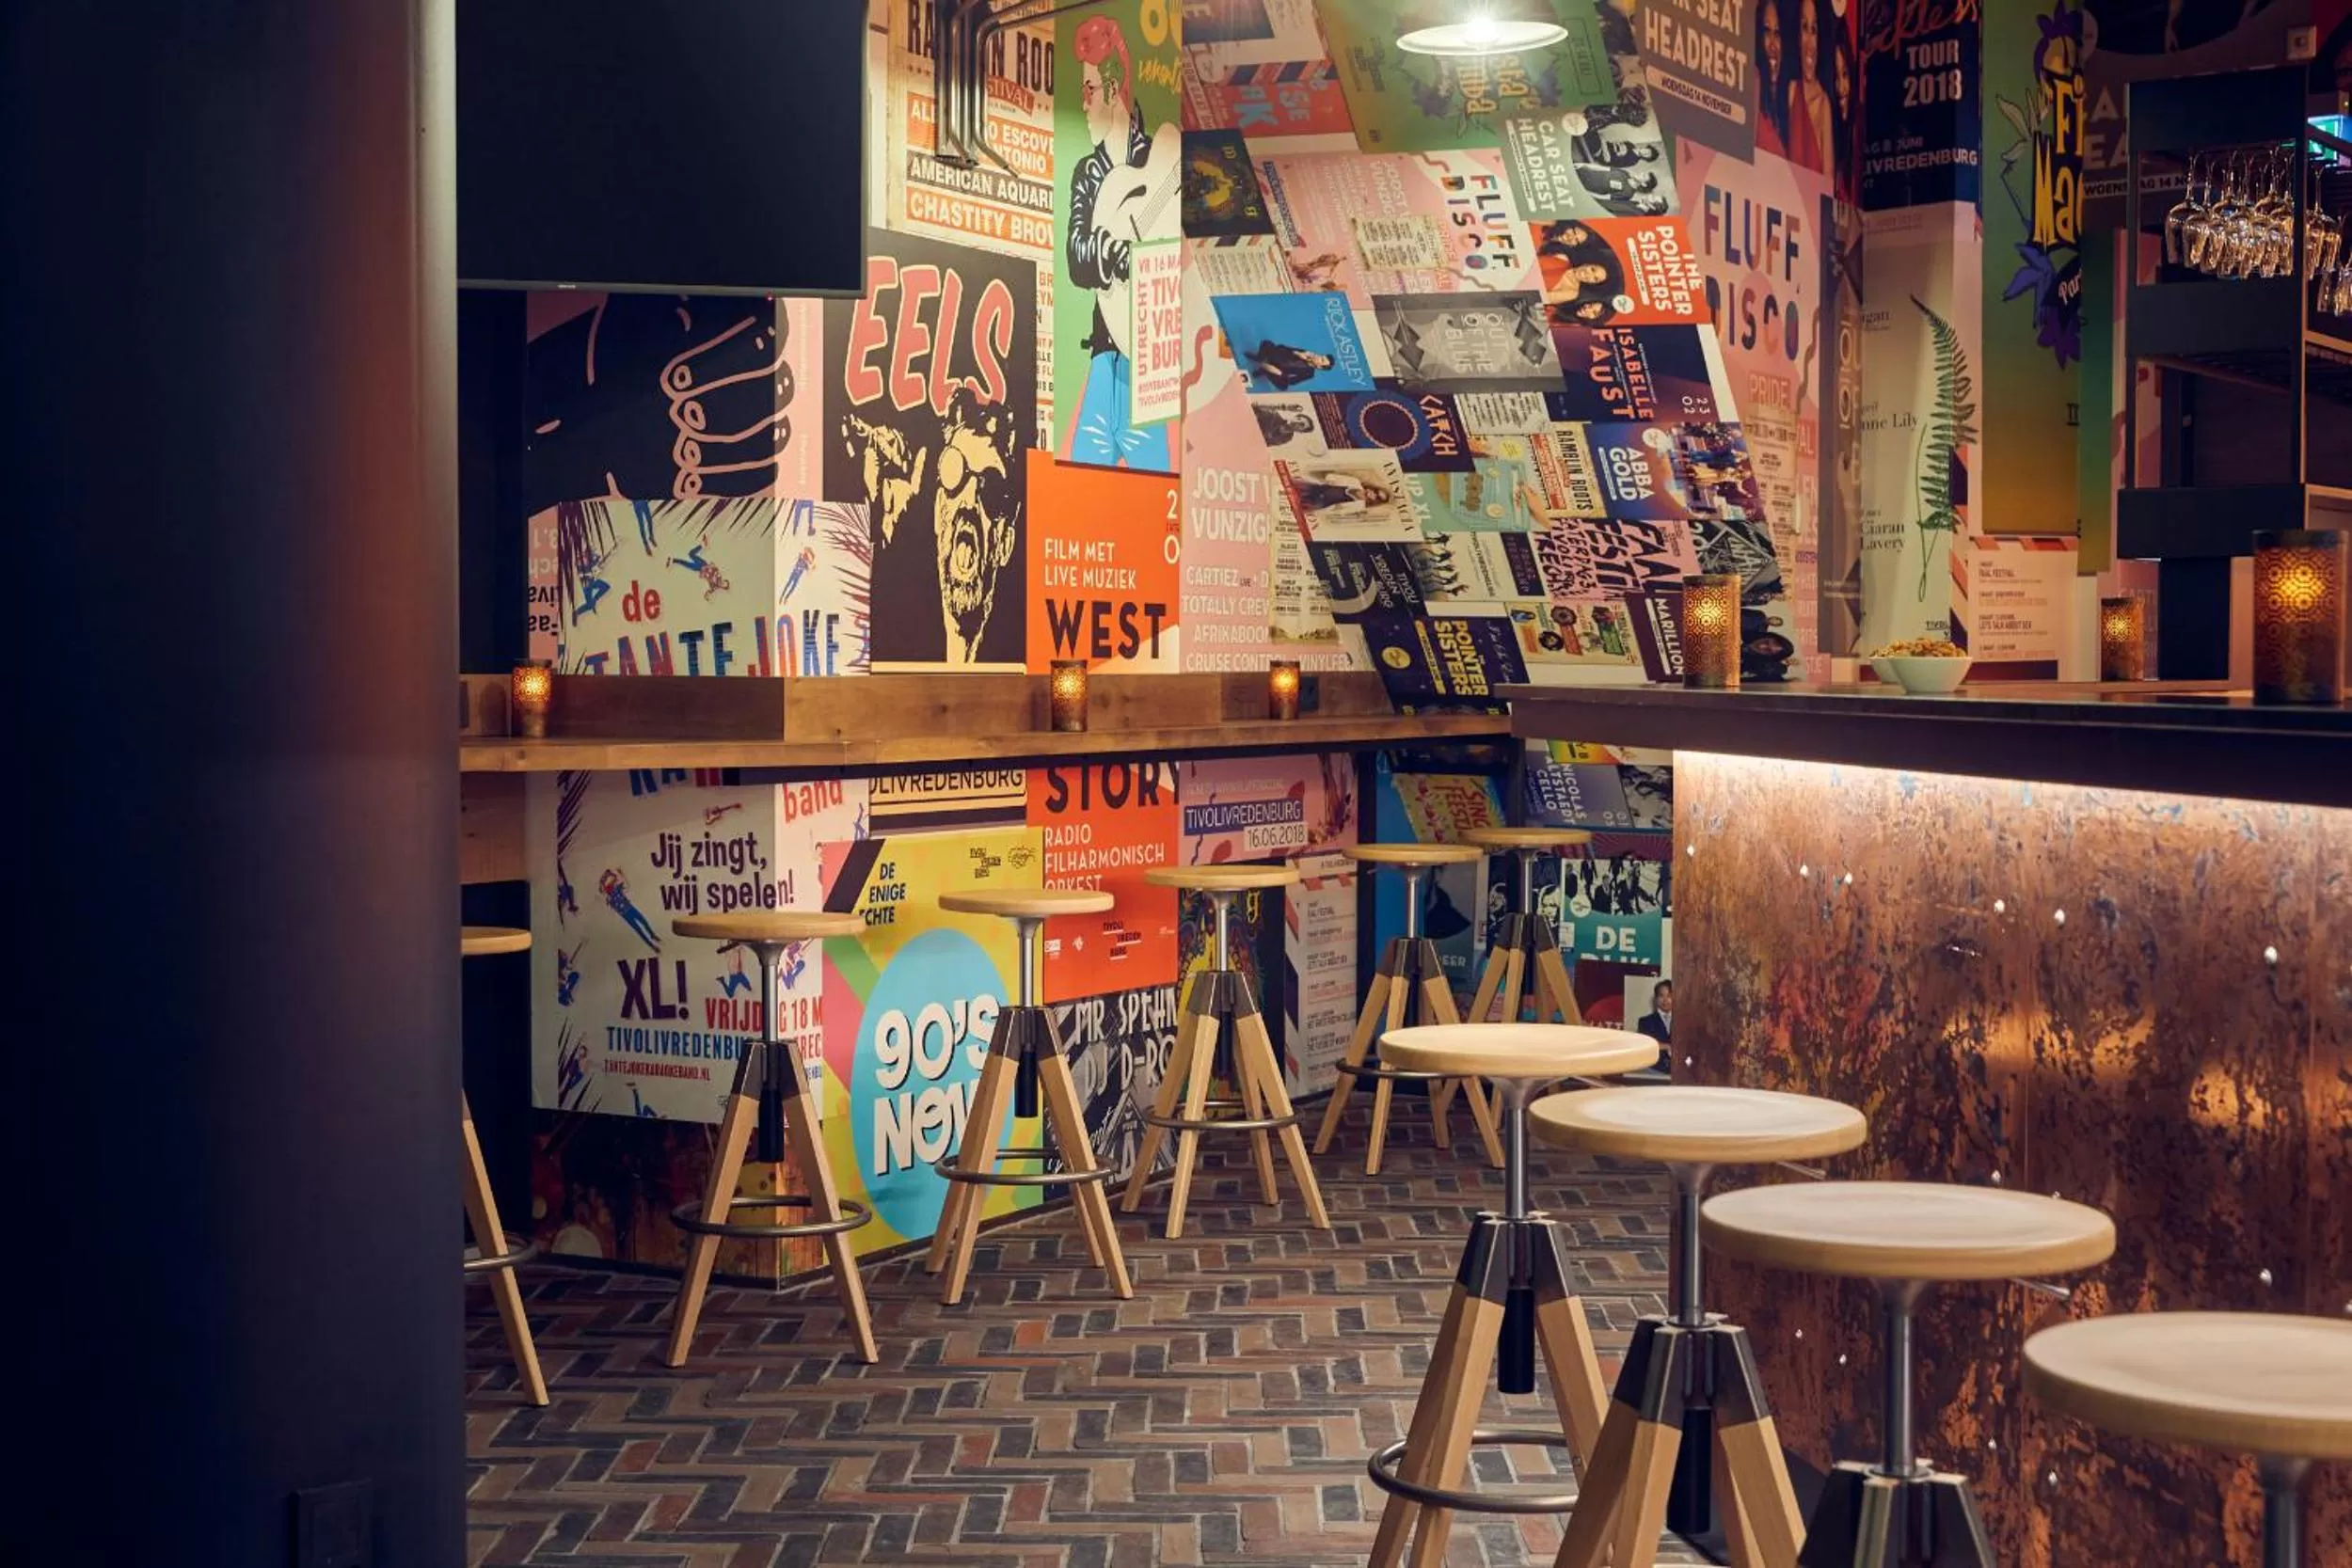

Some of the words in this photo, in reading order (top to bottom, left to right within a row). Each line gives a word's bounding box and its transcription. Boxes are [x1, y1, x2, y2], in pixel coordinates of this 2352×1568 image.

[1645, 8, 1747, 91] HEADREST
[1907, 39, 1959, 71] TOUR
[1903, 70, 1963, 108] 2018
[911, 158, 993, 198] AMERICAN
[992, 146, 1046, 174] NTONIO
[1517, 118, 1556, 212] HEADREST
[1537, 120, 1560, 159] CAR
[1549, 164, 1575, 209] SEAT
[910, 194, 1005, 231] CHASTITY
[1441, 175, 1488, 270] DISCO
[1470, 174, 1520, 271] FLUFF
[1704, 183, 1801, 282] FLUFF
[1637, 231, 1672, 311] SISTERS
[1656, 226, 1693, 316] POINTER
[1682, 253, 1704, 292] THE
[846, 256, 1015, 417] EELS
[1137, 279, 1148, 376] UTRECHT
[1706, 275, 1800, 361] DISCO
[1325, 296, 1346, 333] RICK
[1340, 336, 1366, 387] ASTLEY
[1589, 328, 1635, 419] FAUST
[1616, 327, 1655, 421] ISABELLE
[1748, 373, 1791, 411] PRIDE
[1892, 411, 1918, 432] Lily
[1192, 467, 1260, 500] JOOST
[1555, 430, 1583, 474] RAMBLIN
[1570, 479, 1594, 511] ROOTS
[1610, 447, 1639, 500] GOLD
[1627, 447, 1655, 499] ABBA
[1044, 538, 1079, 561] FILM
[1085, 541, 1115, 562] MET
[1044, 564, 1077, 588] LIVE
[1082, 567, 1136, 590] MUZIEK
[622, 579, 661, 623] de
[1182, 596, 1234, 616] TOTALLY
[584, 622, 734, 676] TANTE
[747, 609, 840, 676] JOKE
[1045, 598, 1167, 659] WEST
[1655, 597, 1684, 675] MARILLION
[1186, 653, 1231, 672] CRUISE
[1434, 620, 1472, 696] SISTERS
[1453, 620, 1489, 696] POINTER
[783, 779, 843, 824] band
[1535, 768, 1558, 811] CELLO
[1563, 763, 1588, 820] NICOLAS
[1044, 824, 1091, 847] RADIO
[1186, 802, 1302, 828] TIVOLIVREDENBURG
[1247, 826, 1305, 847] 16.06.2018
[651, 832, 682, 879] Jij
[691, 832, 768, 876] zingt,
[880, 862, 896, 879] DE
[1044, 843, 1165, 873] FILHARMONISCH
[660, 878, 698, 915] wij
[707, 870, 794, 914] spelen!
[869, 882, 906, 903] ENIGE
[1044, 874, 1102, 891] ORKEST
[1596, 926, 1637, 954] DE
[617, 957, 689, 1021] XL!
[706, 996, 787, 1032] VRIJDG
[791, 997, 808, 1030] 18
[1074, 999, 1105, 1044] MR
[875, 993, 1000, 1091] 90'S
[1083, 1064, 1107, 1097] DJ
